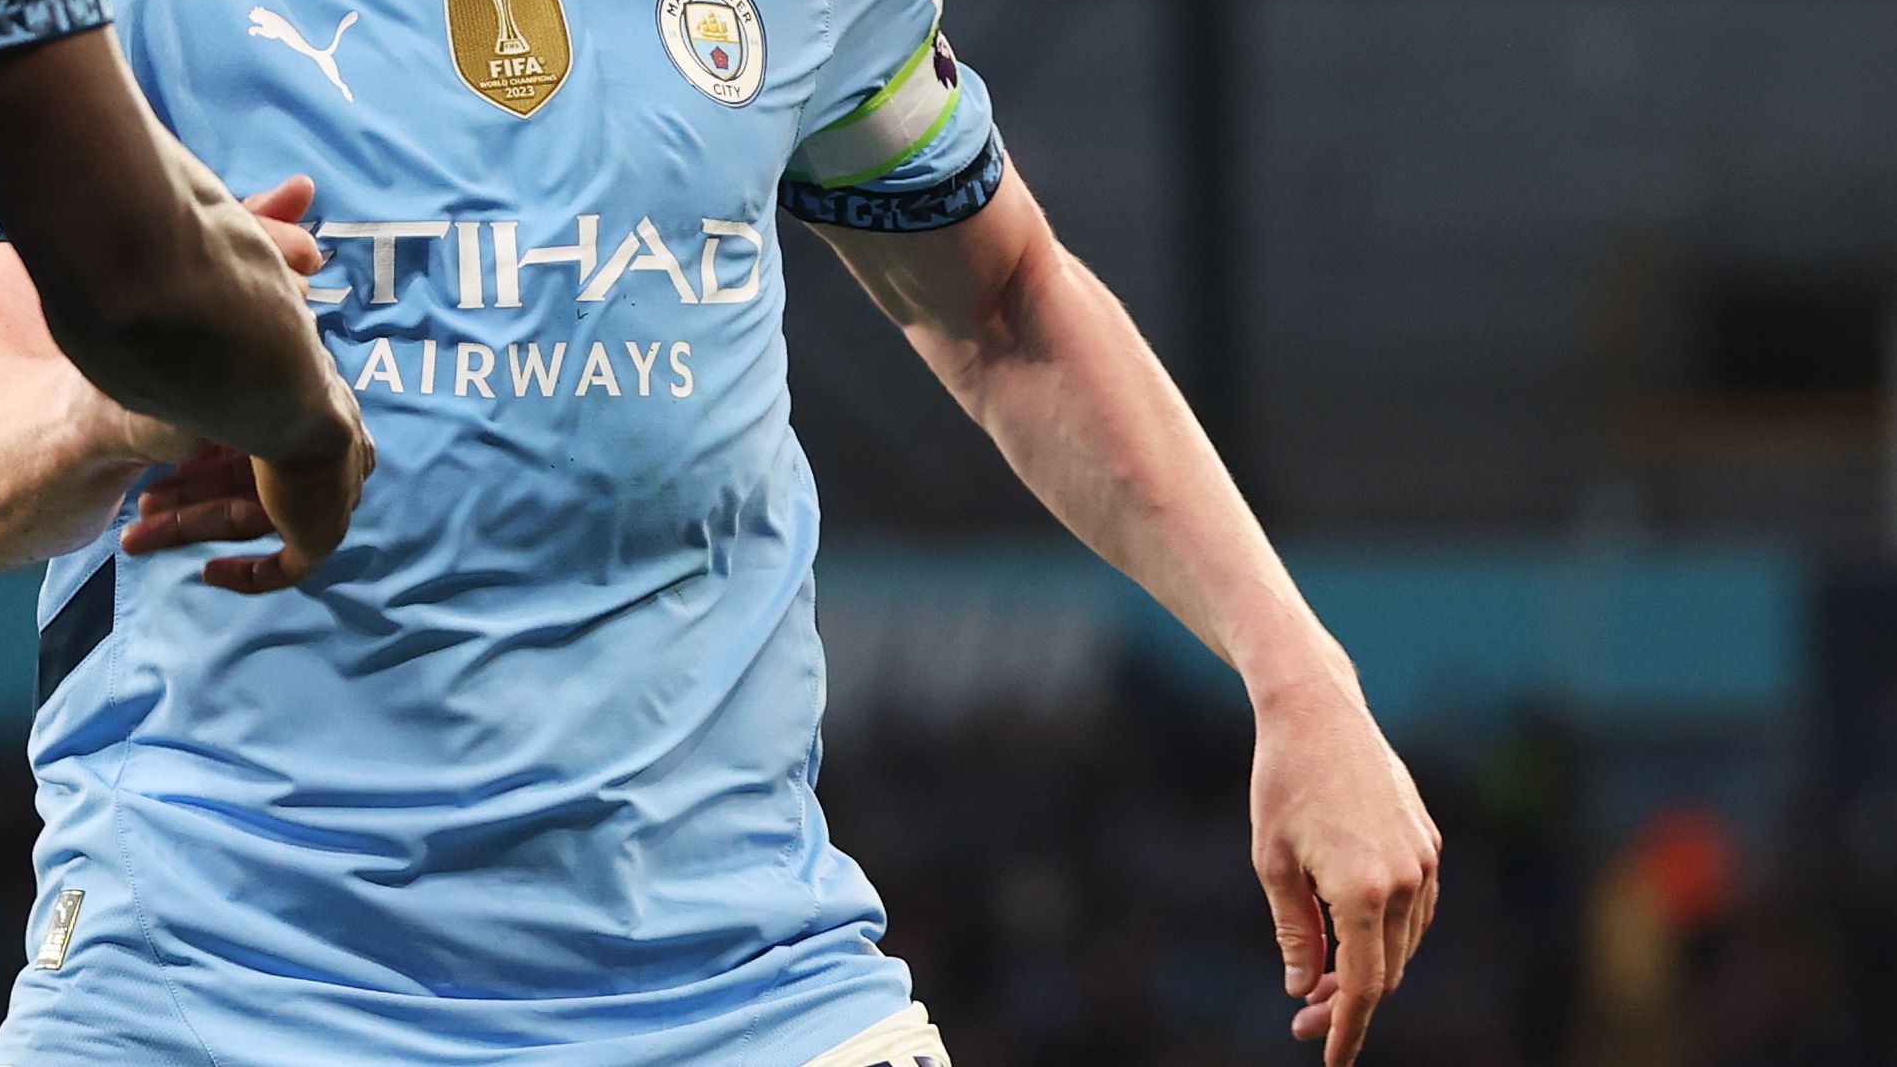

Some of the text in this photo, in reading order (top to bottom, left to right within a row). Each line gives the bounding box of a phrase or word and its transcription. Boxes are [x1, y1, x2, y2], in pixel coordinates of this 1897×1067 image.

[489, 56, 543, 78] FIFA
[480, 74, 558, 89] WORLD CHAMPIONS
[505, 85, 536, 99] 2023
[713, 83, 741, 98] CITY
[353, 336, 695, 399] AIRWAYS
